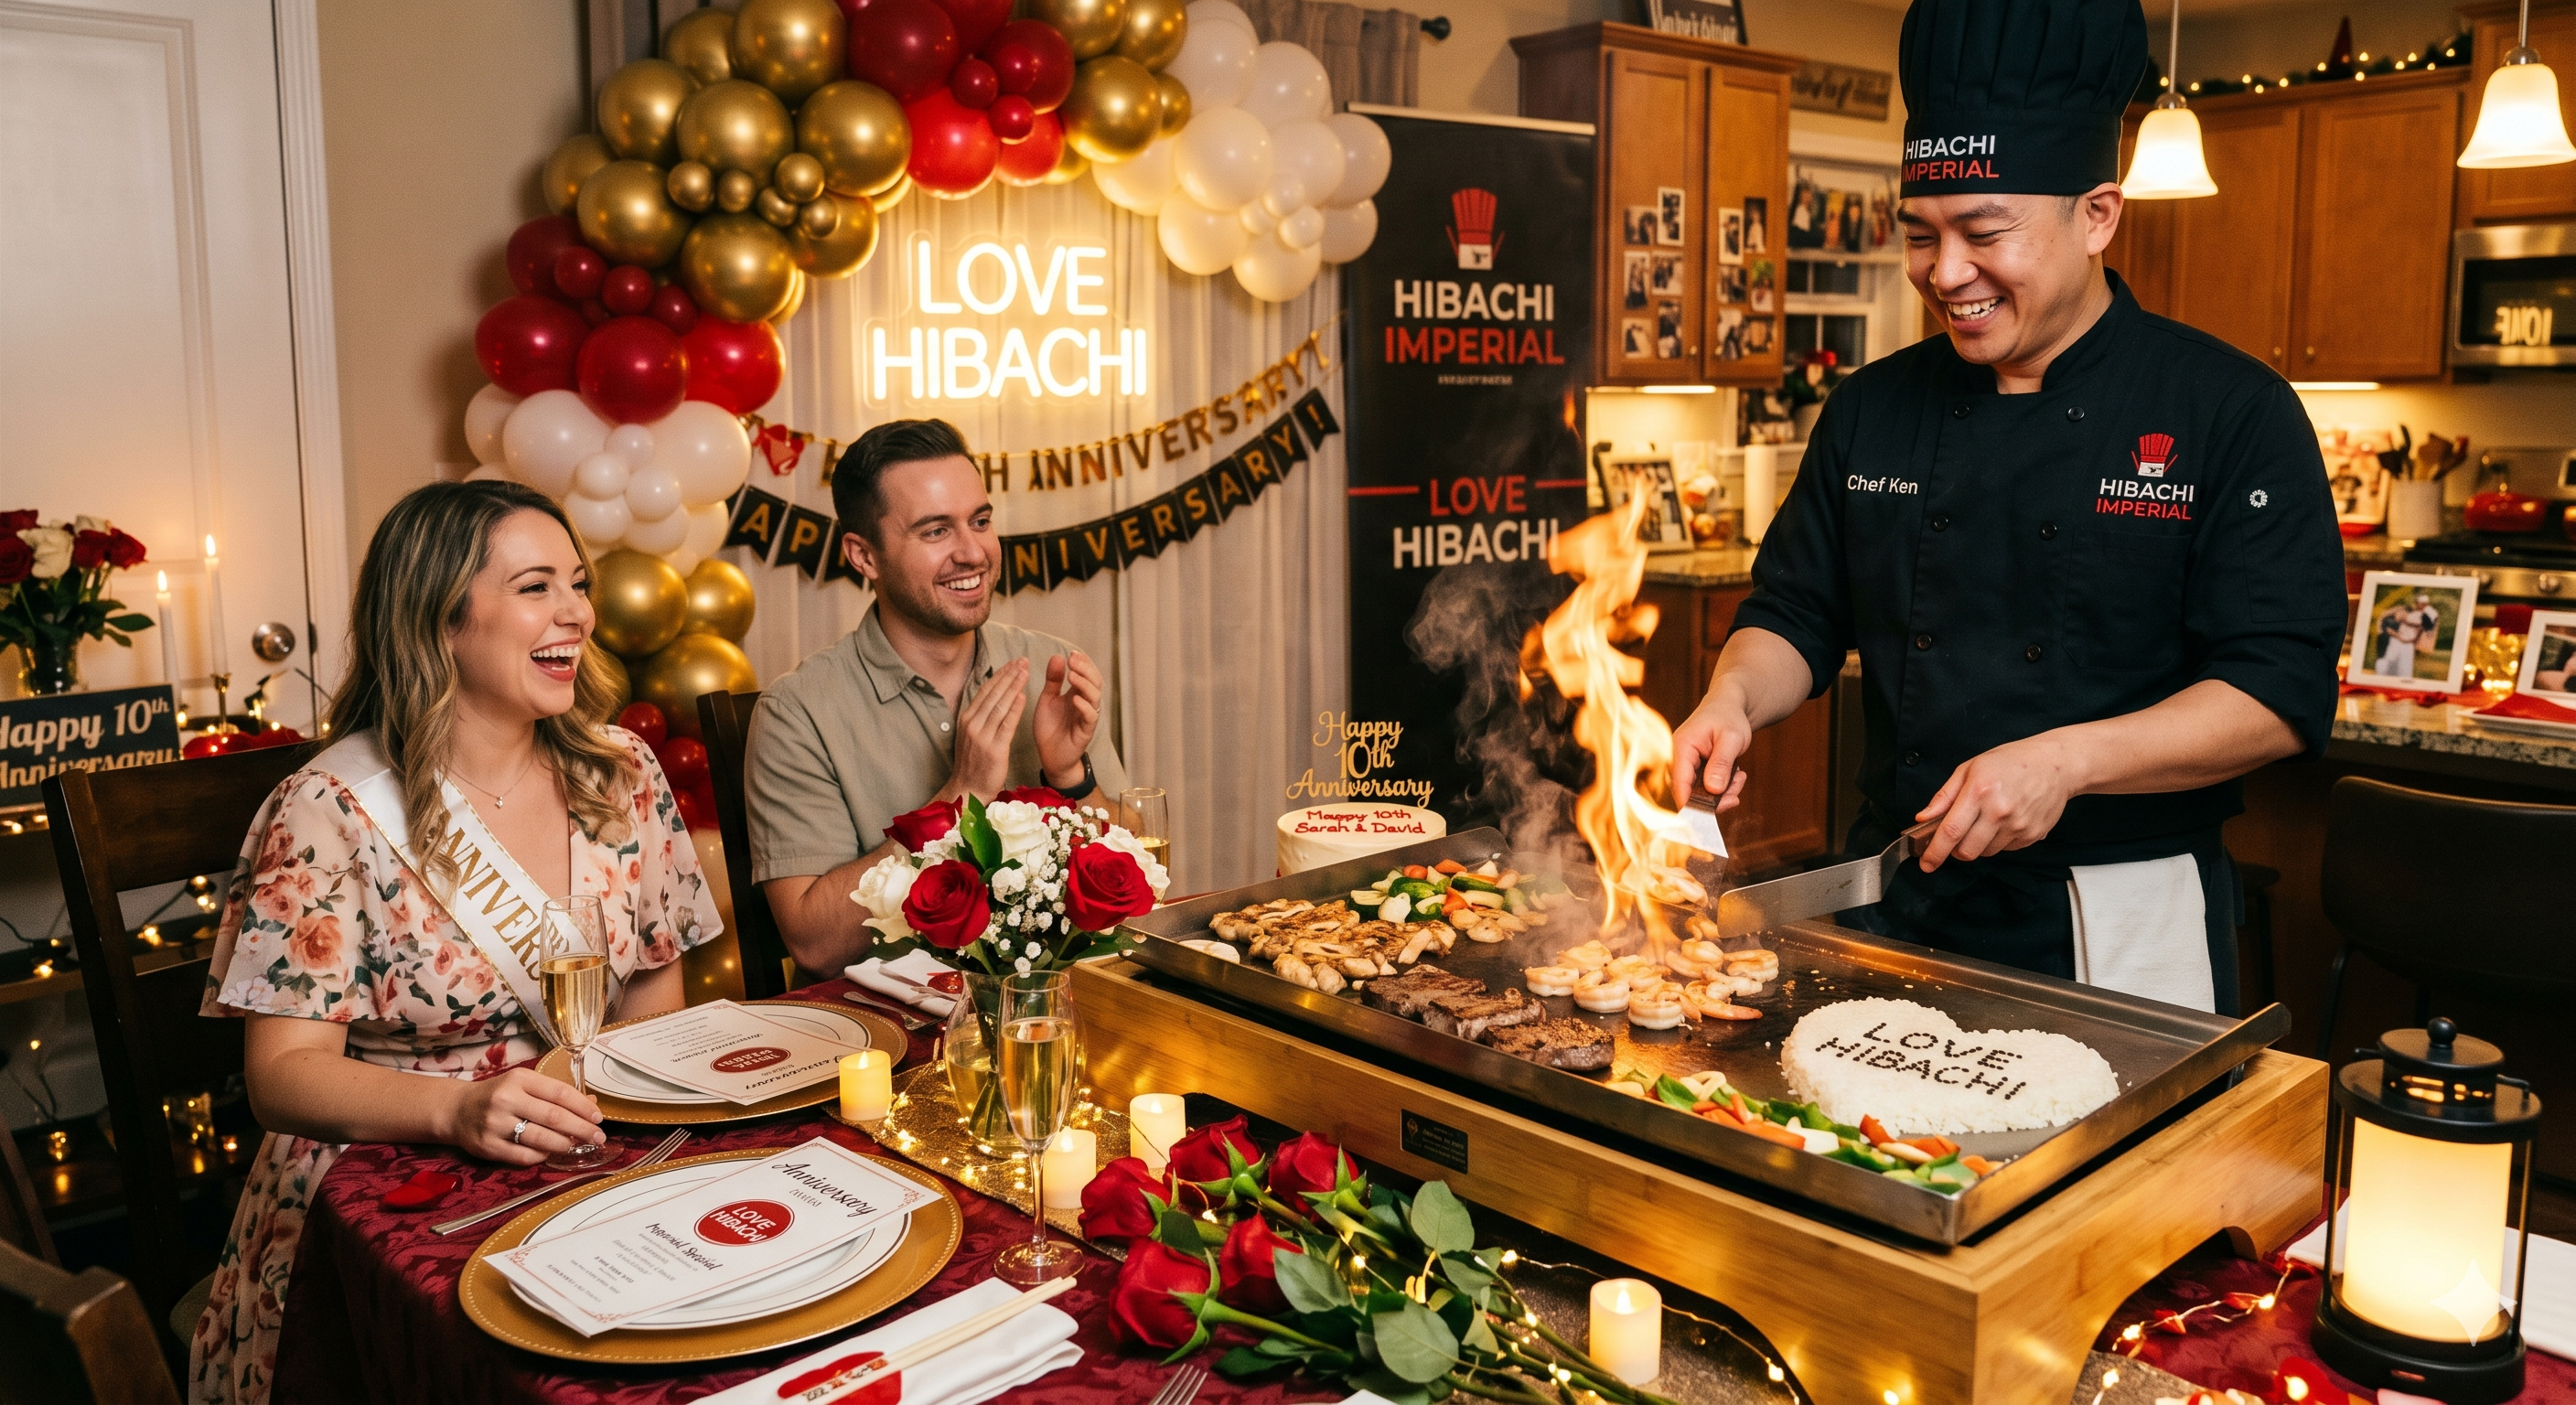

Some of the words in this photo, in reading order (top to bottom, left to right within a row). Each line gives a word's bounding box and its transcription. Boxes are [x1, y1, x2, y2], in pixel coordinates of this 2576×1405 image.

[1905, 134, 1996, 160] HIBACHI
[1903, 159, 2000, 183] IMPERIAL
[918, 240, 1109, 316] LOVE
[1394, 279, 1554, 321] HIBACHI
[873, 327, 1147, 400] HIBACHI
[1385, 326, 1565, 365] IMPERIAL
[1429, 475, 1527, 517] LOVE
[1847, 474, 1886, 492] Chef
[1888, 477, 1918, 495] Ken
[2098, 477, 2195, 502] HIBACHI
[2096, 498, 2193, 520] IMPERIAL
[1392, 518, 1559, 569] HIBACHI
[113, 696, 171, 736] 10th
[1313, 711, 1404, 750] Happy
[0, 747, 173, 789] nniversar
[1334, 739, 1395, 779] 10th
[1285, 768, 1434, 809] Anniversary
[1294, 820, 1349, 833] Sarah
[1354, 823, 1368, 833] &
[1371, 821, 1426, 834] David
[1373, 809, 1411, 820] 10th
[1862, 1021, 2023, 1071] LOVE
[1814, 1035, 2027, 1100] HIBACHI
[771, 1163, 878, 1218] Anniversary
[731, 1206, 777, 1231] LOVE
